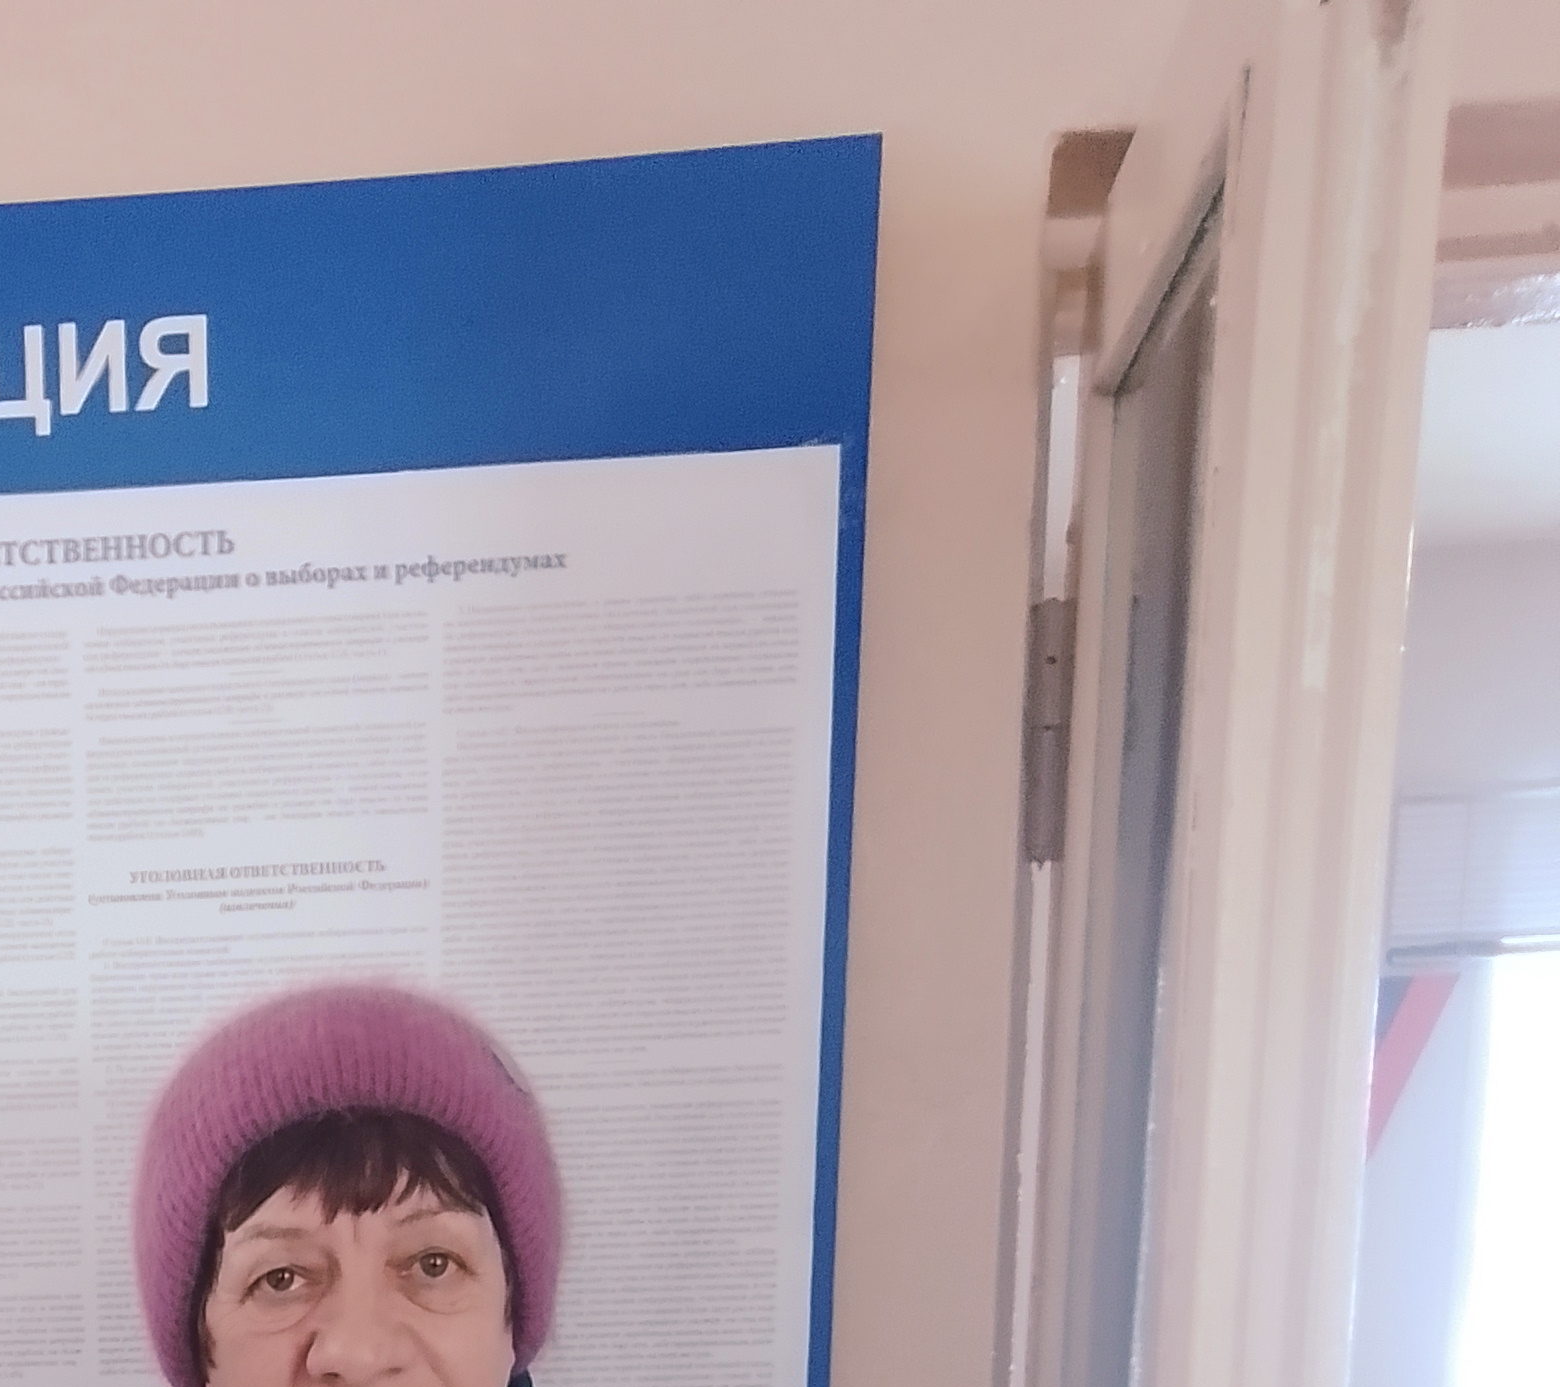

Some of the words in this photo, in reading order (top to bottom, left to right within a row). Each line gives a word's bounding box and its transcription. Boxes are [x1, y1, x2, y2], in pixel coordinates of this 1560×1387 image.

[110, 571, 240, 599] Федерации
[244, 572, 262, 588] о
[265, 561, 367, 589] выборах
[372, 566, 390, 582] и
[394, 551, 568, 585] референдумах
